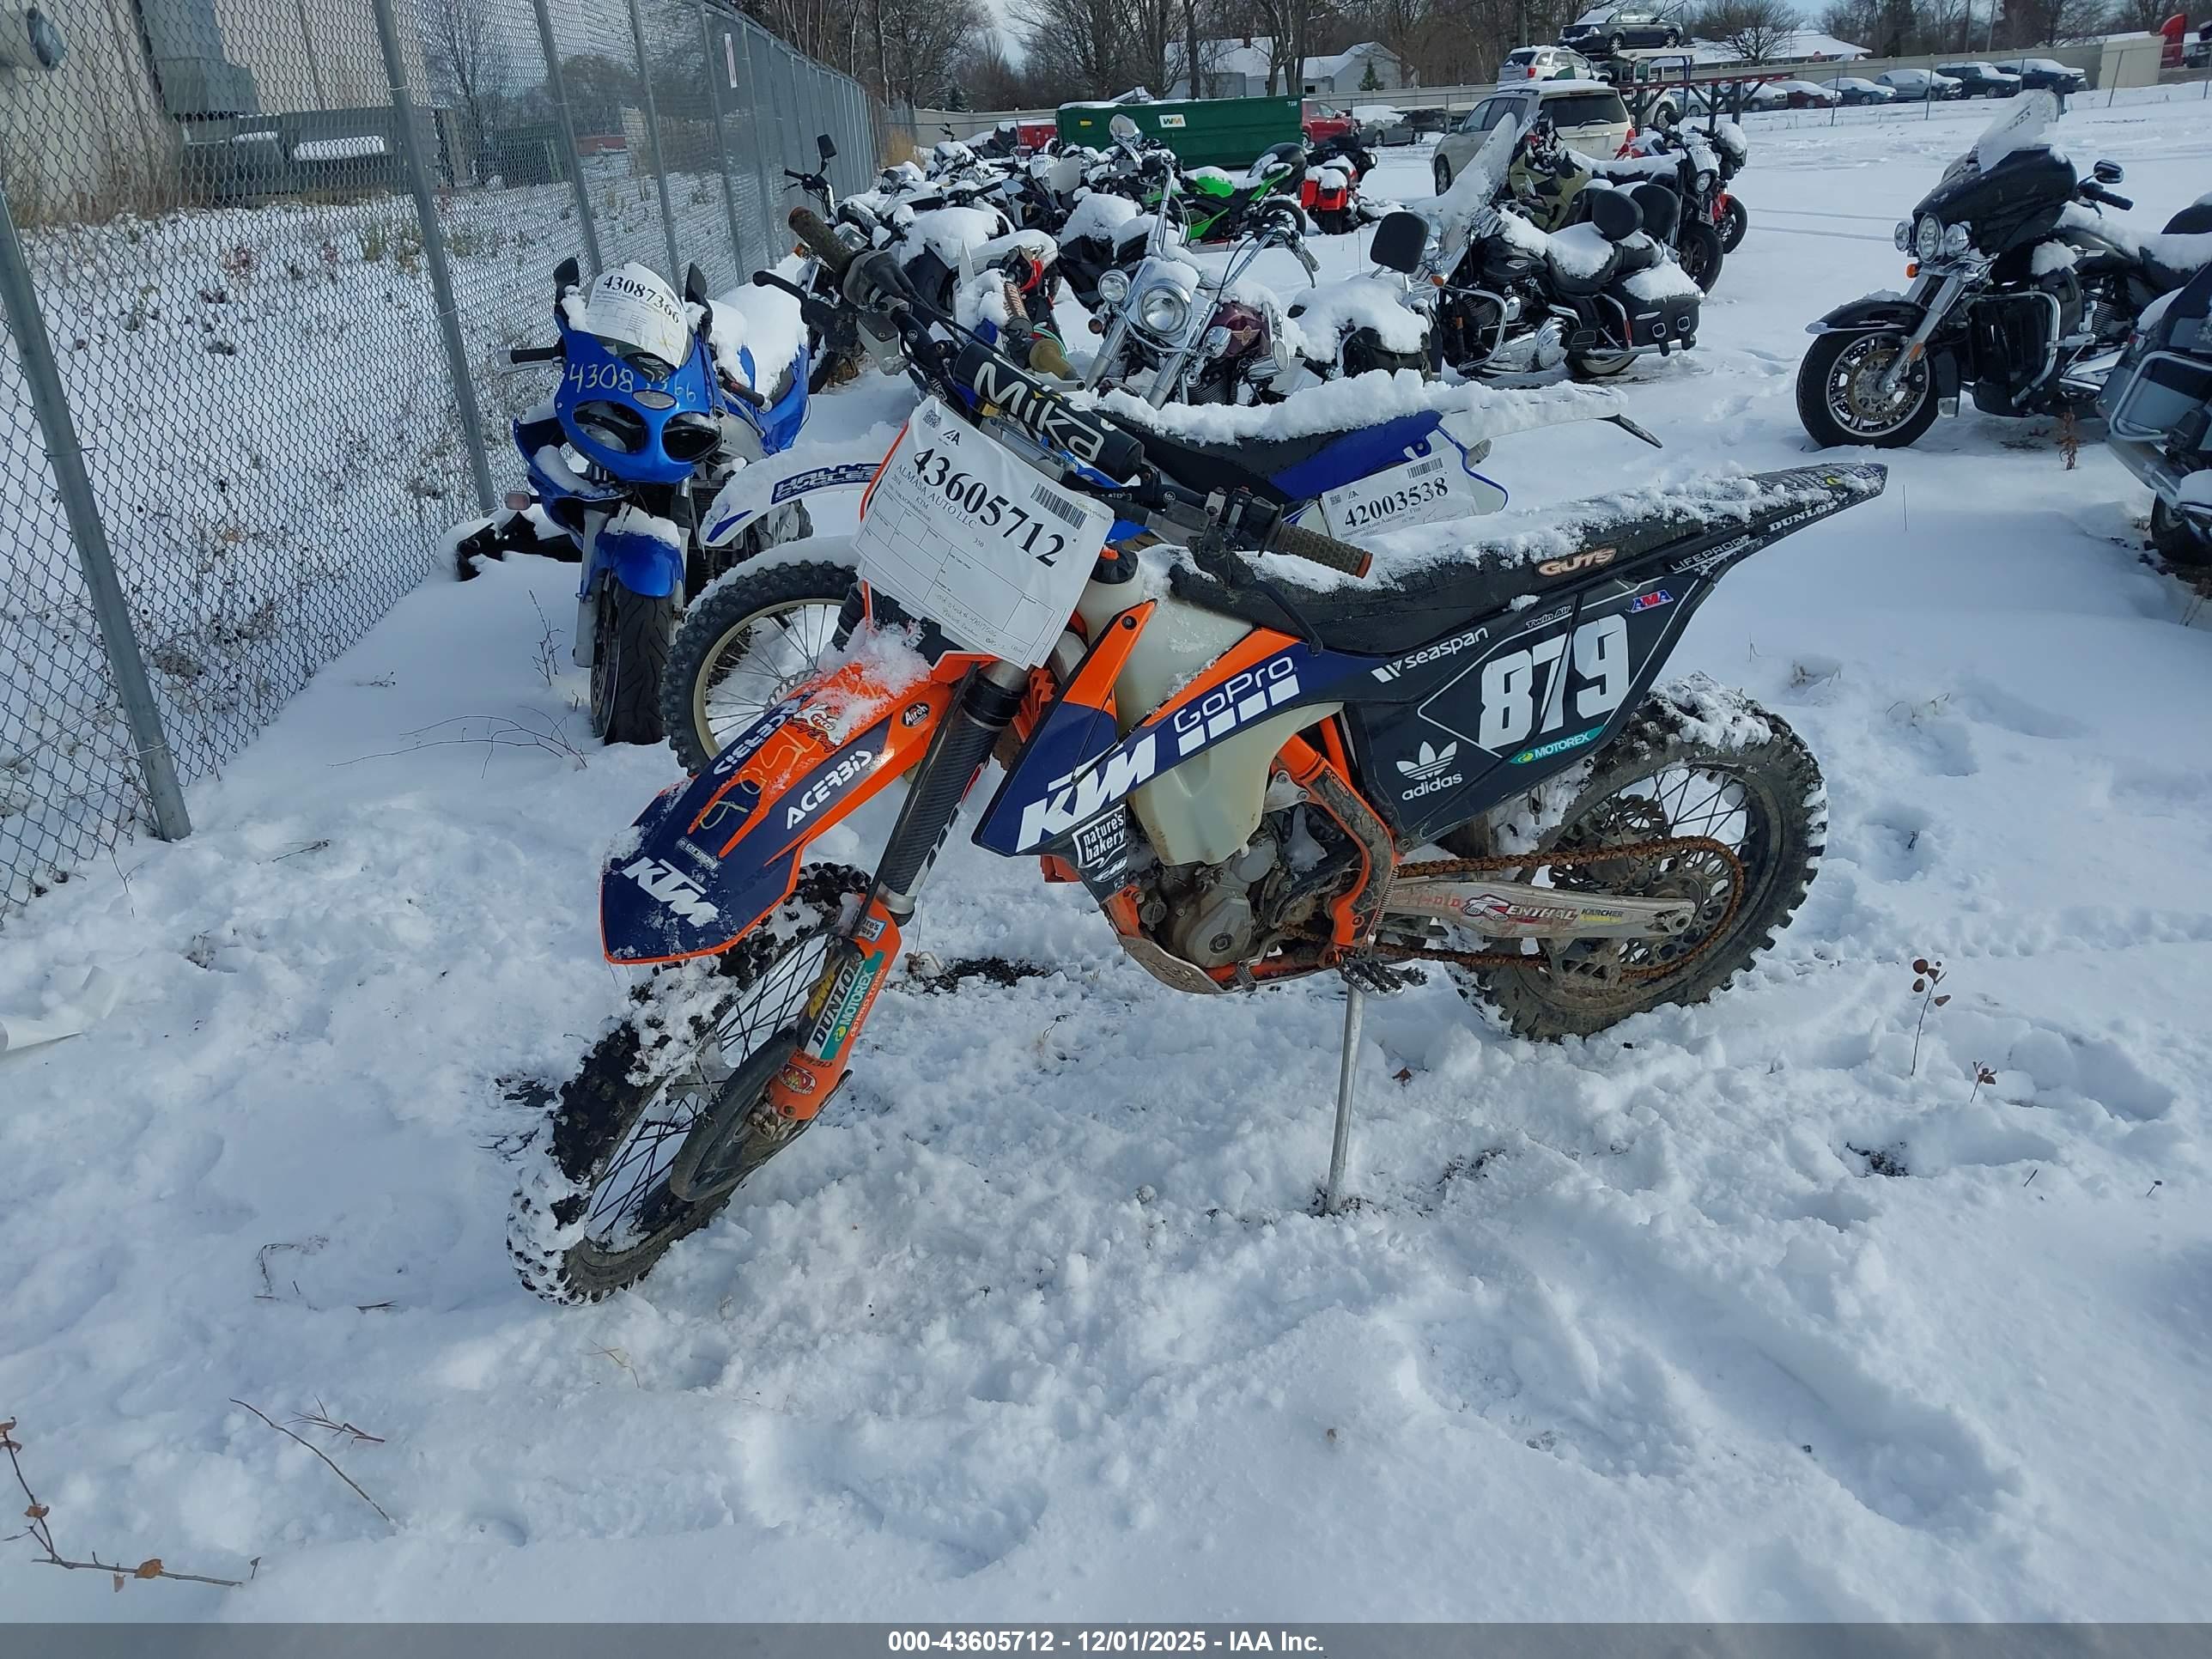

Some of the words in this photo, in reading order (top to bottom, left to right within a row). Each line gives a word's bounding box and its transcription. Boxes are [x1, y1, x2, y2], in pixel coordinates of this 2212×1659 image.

[604, 274, 680, 324] 43087366
[974, 362, 1104, 462] Mika
[896, 464, 927, 495] ALMASA
[928, 492, 957, 515] AUTO
[956, 511, 977, 529] LLC
[914, 447, 1065, 568] 43605712
[915, 495, 929, 510] KTM
[1345, 477, 1449, 527] 42003538
[1340, 526, 1365, 538] Insurance
[1367, 520, 1381, 530] Auto
[1538, 548, 1617, 576] GUTS
[1525, 614, 1554, 629] Twin
[1553, 605, 1572, 618] Air
[1632, 589, 1674, 613] AMA
[1404, 627, 1488, 669] seaspan
[1173, 656, 1294, 733] GoPro
[1479, 614, 1629, 750] 879
[904, 705, 929, 726] Airoh
[1534, 733, 1589, 758] MOTOREX
[787, 750, 872, 830] ACERBIS
[1016, 733, 1156, 853] KTM
[1401, 773, 1463, 800] adidas
[1083, 813, 1124, 847] nature's
[1085, 829, 1125, 861] bakery
[621, 856, 720, 927] KTM
[840, 971, 875, 1025] MOTOREX
